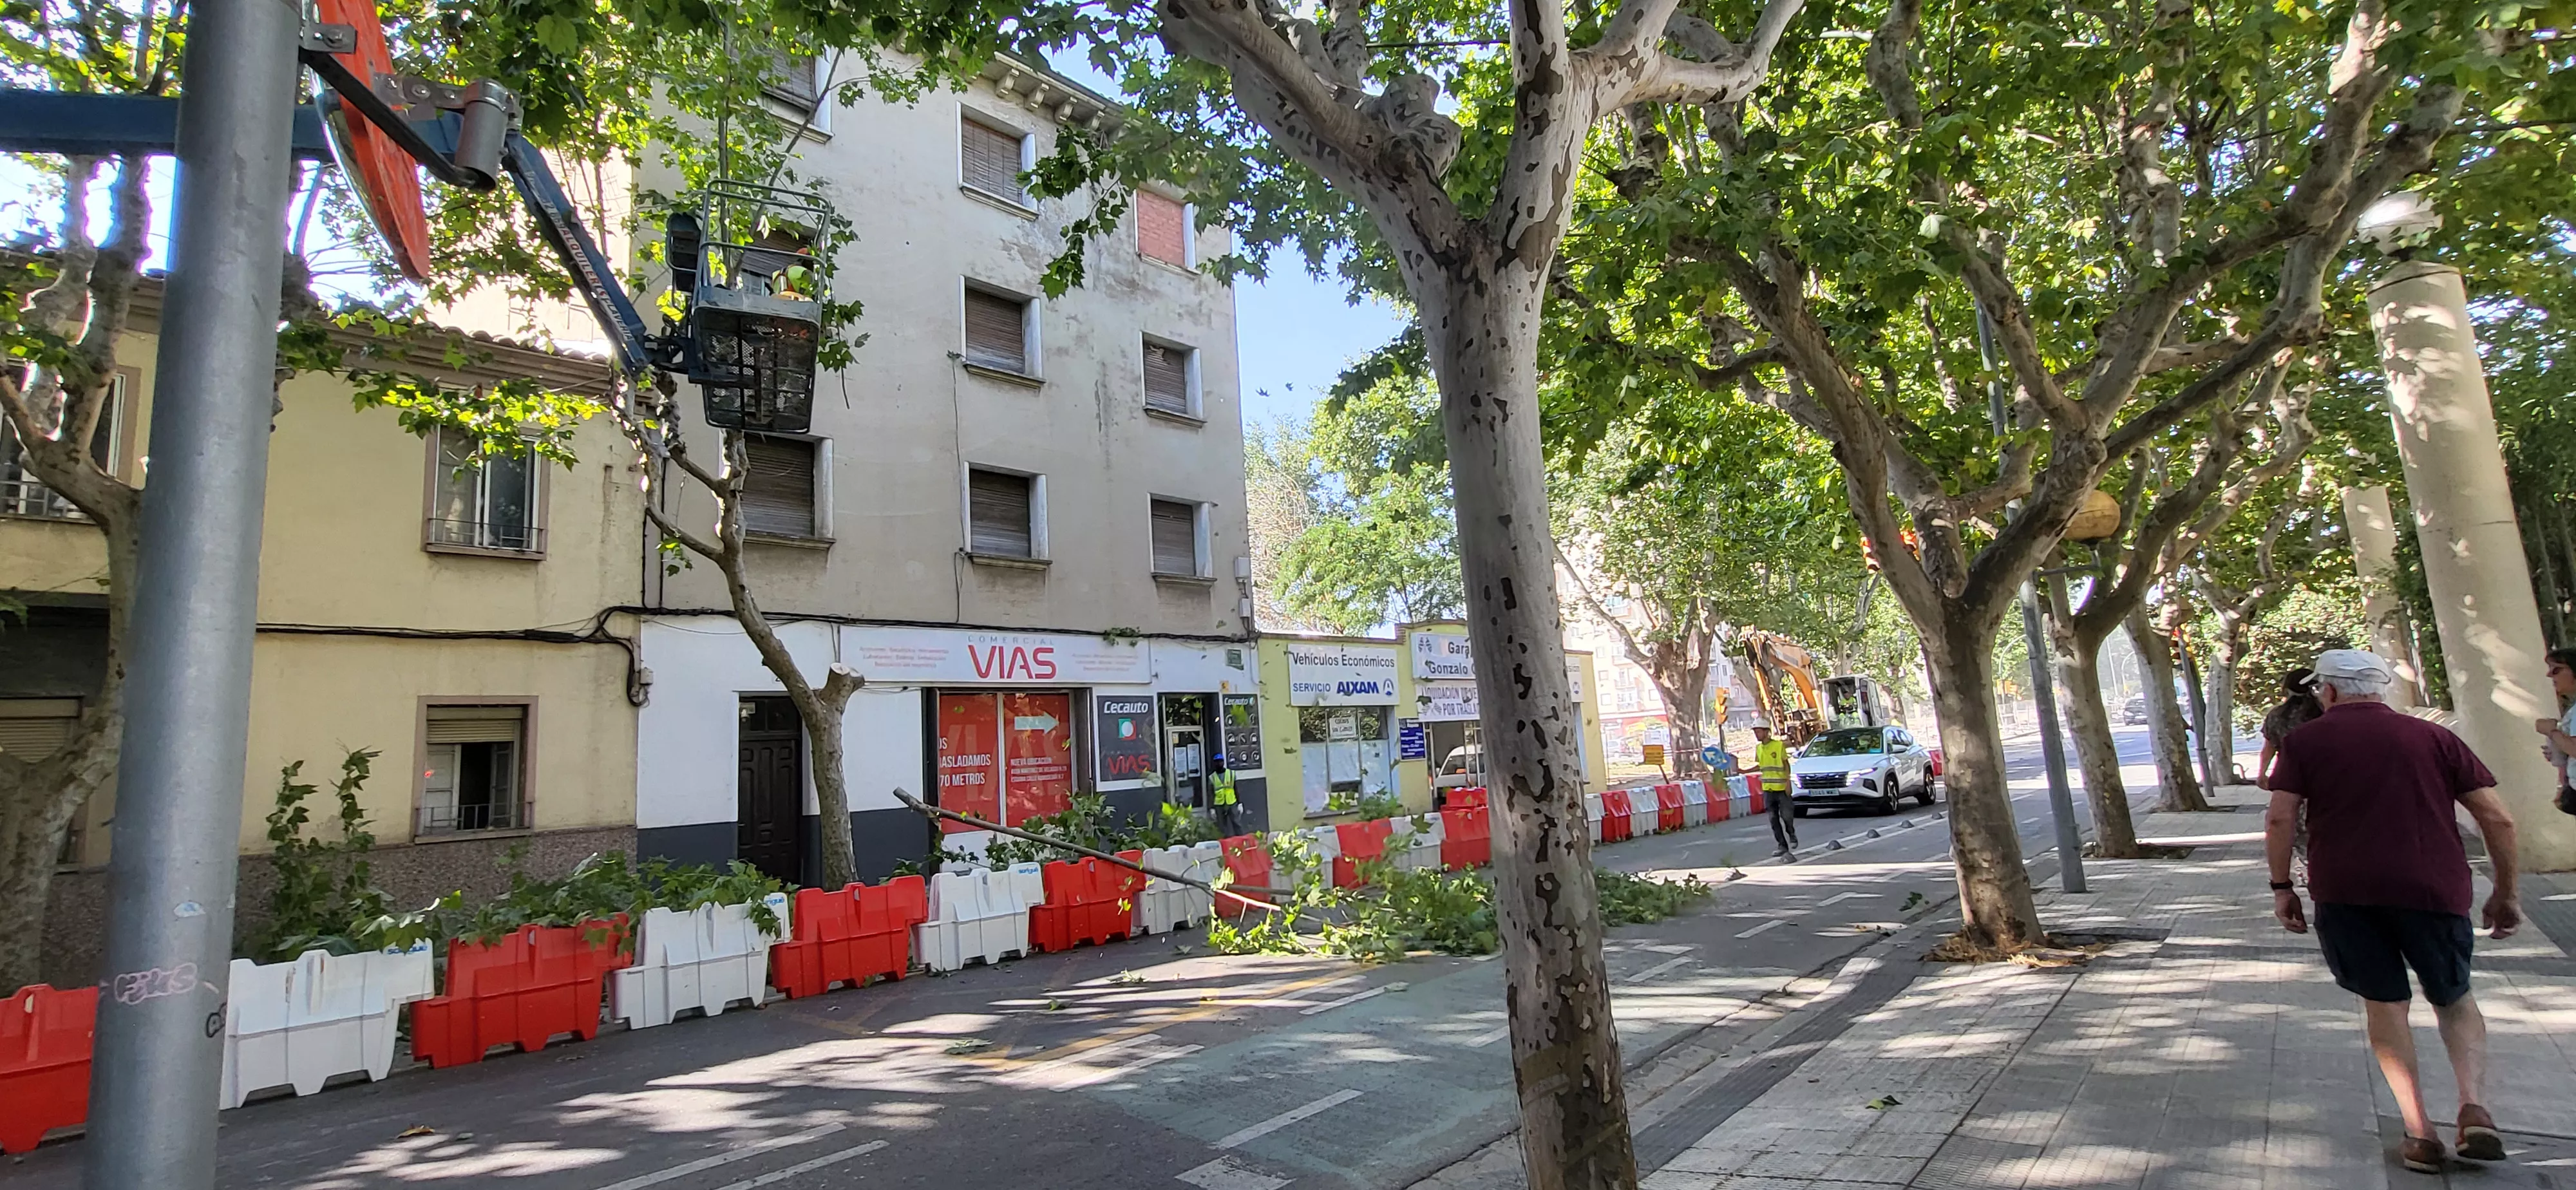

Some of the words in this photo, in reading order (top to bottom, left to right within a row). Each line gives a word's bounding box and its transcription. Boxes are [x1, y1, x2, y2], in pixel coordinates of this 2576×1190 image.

[967, 635, 1054, 645] COMERCIAL
[967, 645, 1057, 679] VIAS
[1293, 652, 1339, 666] Vehículos
[1341, 654, 1395, 668] Económicos
[1428, 661, 1468, 675] Gonzalo
[1293, 683, 1331, 692] SERVICIO
[1336, 681, 1379, 694] AIXAM
[1104, 701, 1149, 713] Cecauto
[1224, 697, 1249, 706] Cecauto
[1443, 703, 1456, 716] POR
[1456, 703, 1479, 715] TRASLA
[1108, 754, 1152, 775] VIAS
[940, 774, 951, 787] 70
[952, 772, 985, 786] METROS
